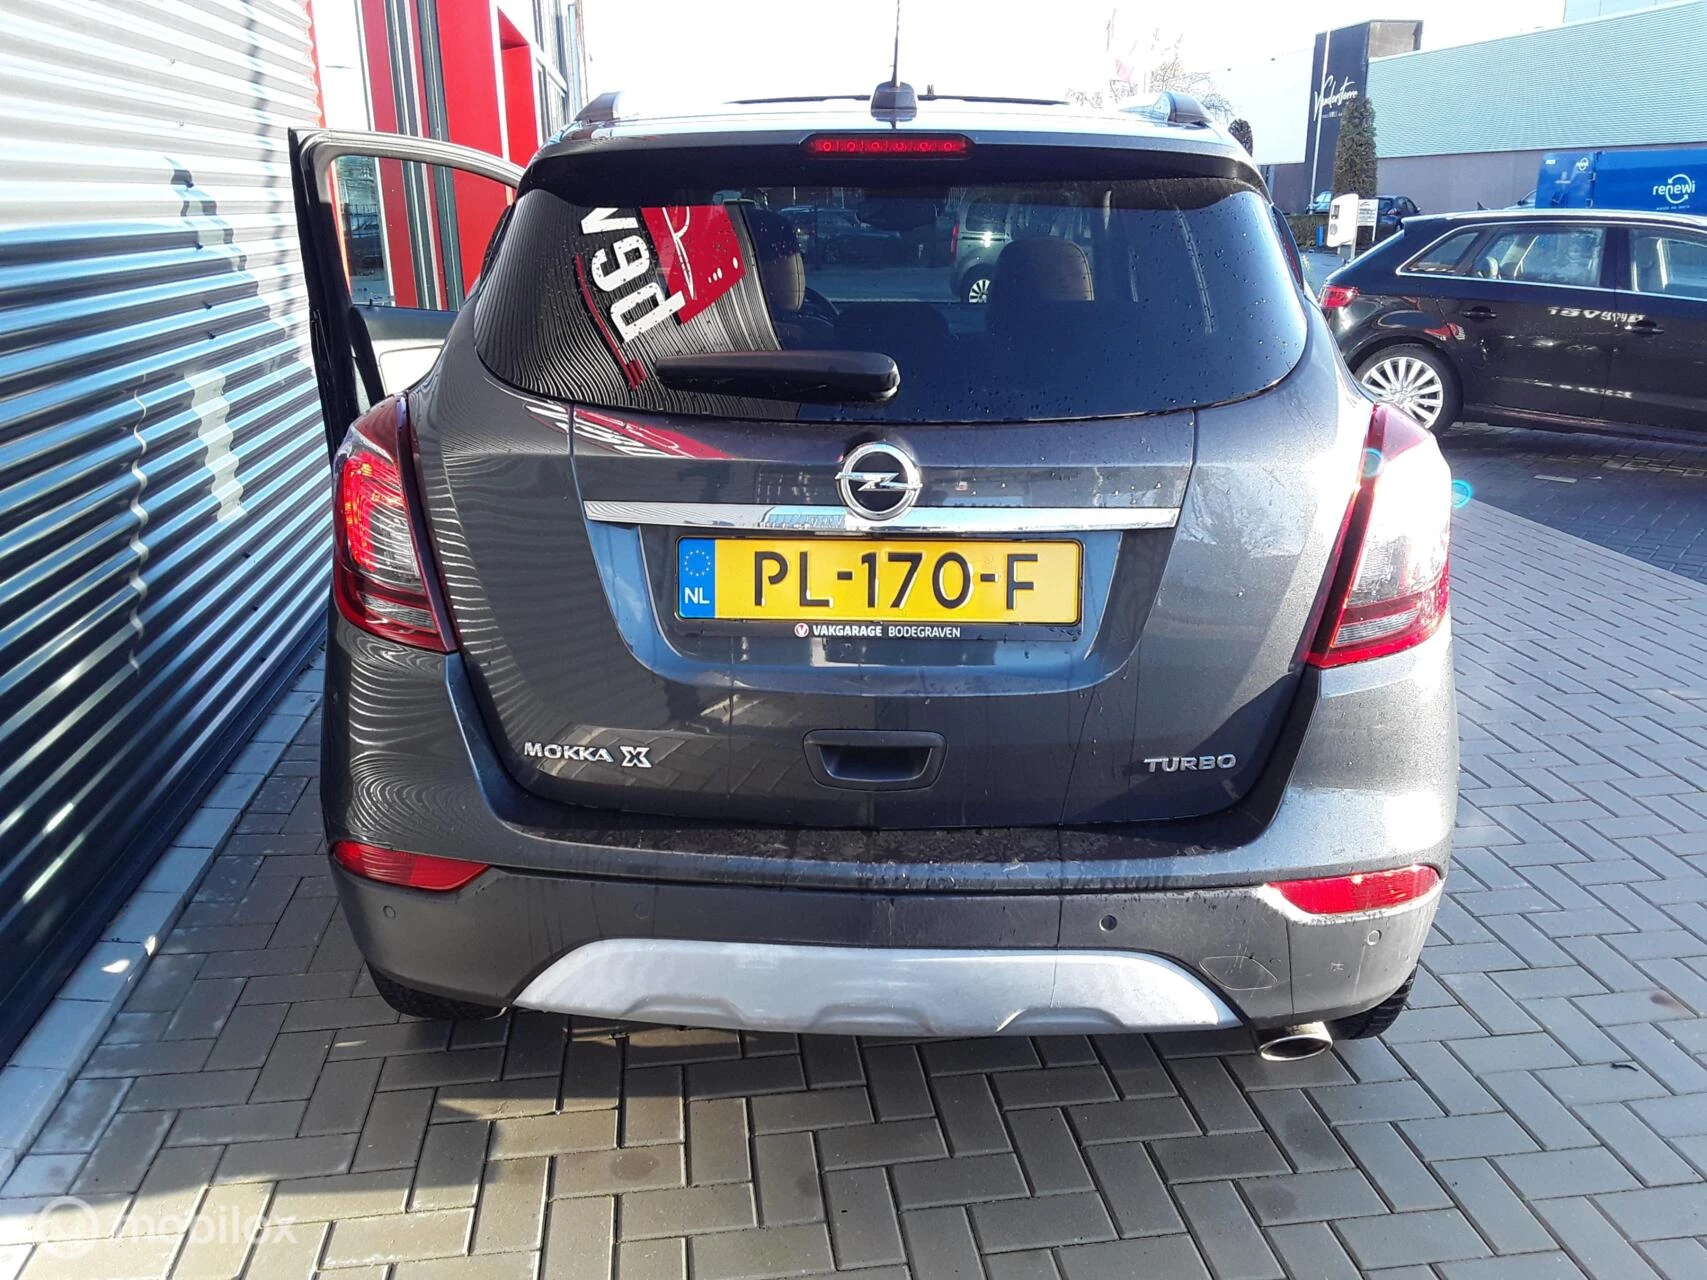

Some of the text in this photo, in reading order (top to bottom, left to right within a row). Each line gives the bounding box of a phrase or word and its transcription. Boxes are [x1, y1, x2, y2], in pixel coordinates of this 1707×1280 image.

[1652, 180, 1696, 195] renewi
[754, 551, 1038, 609] PL-170-F
[684, 587, 710, 604] NL
[812, 625, 882, 636] VAKGARAGE
[888, 626, 961, 638] BODEGRAVEN
[524, 742, 652, 767] MOKKA X
[1143, 753, 1236, 772] TURBO
